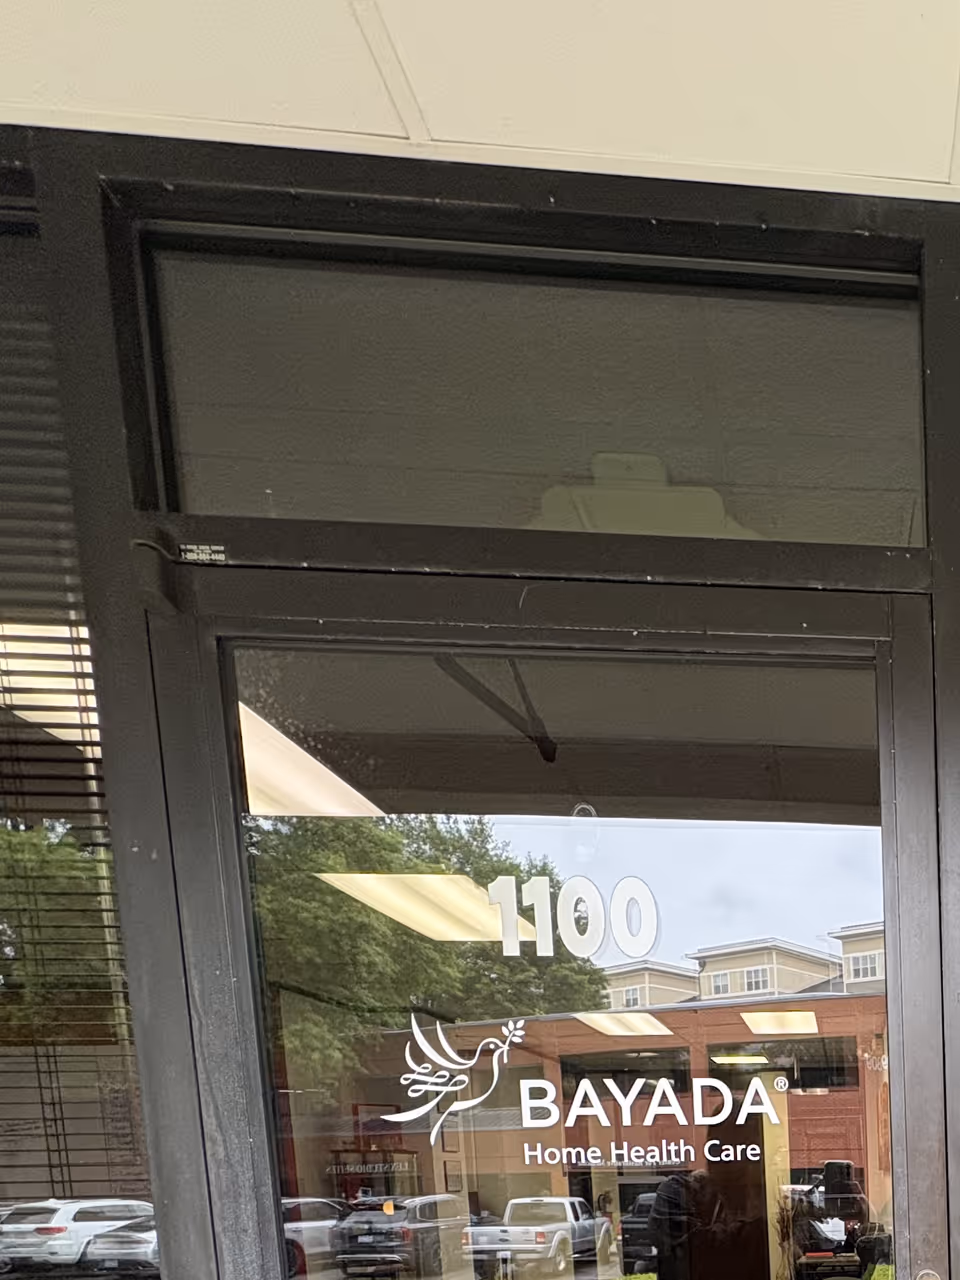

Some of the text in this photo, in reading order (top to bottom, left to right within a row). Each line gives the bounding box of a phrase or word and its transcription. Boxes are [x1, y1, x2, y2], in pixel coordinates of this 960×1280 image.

[488, 875, 659, 958] 1100
[524, 1138, 761, 1166] Home Health Care
